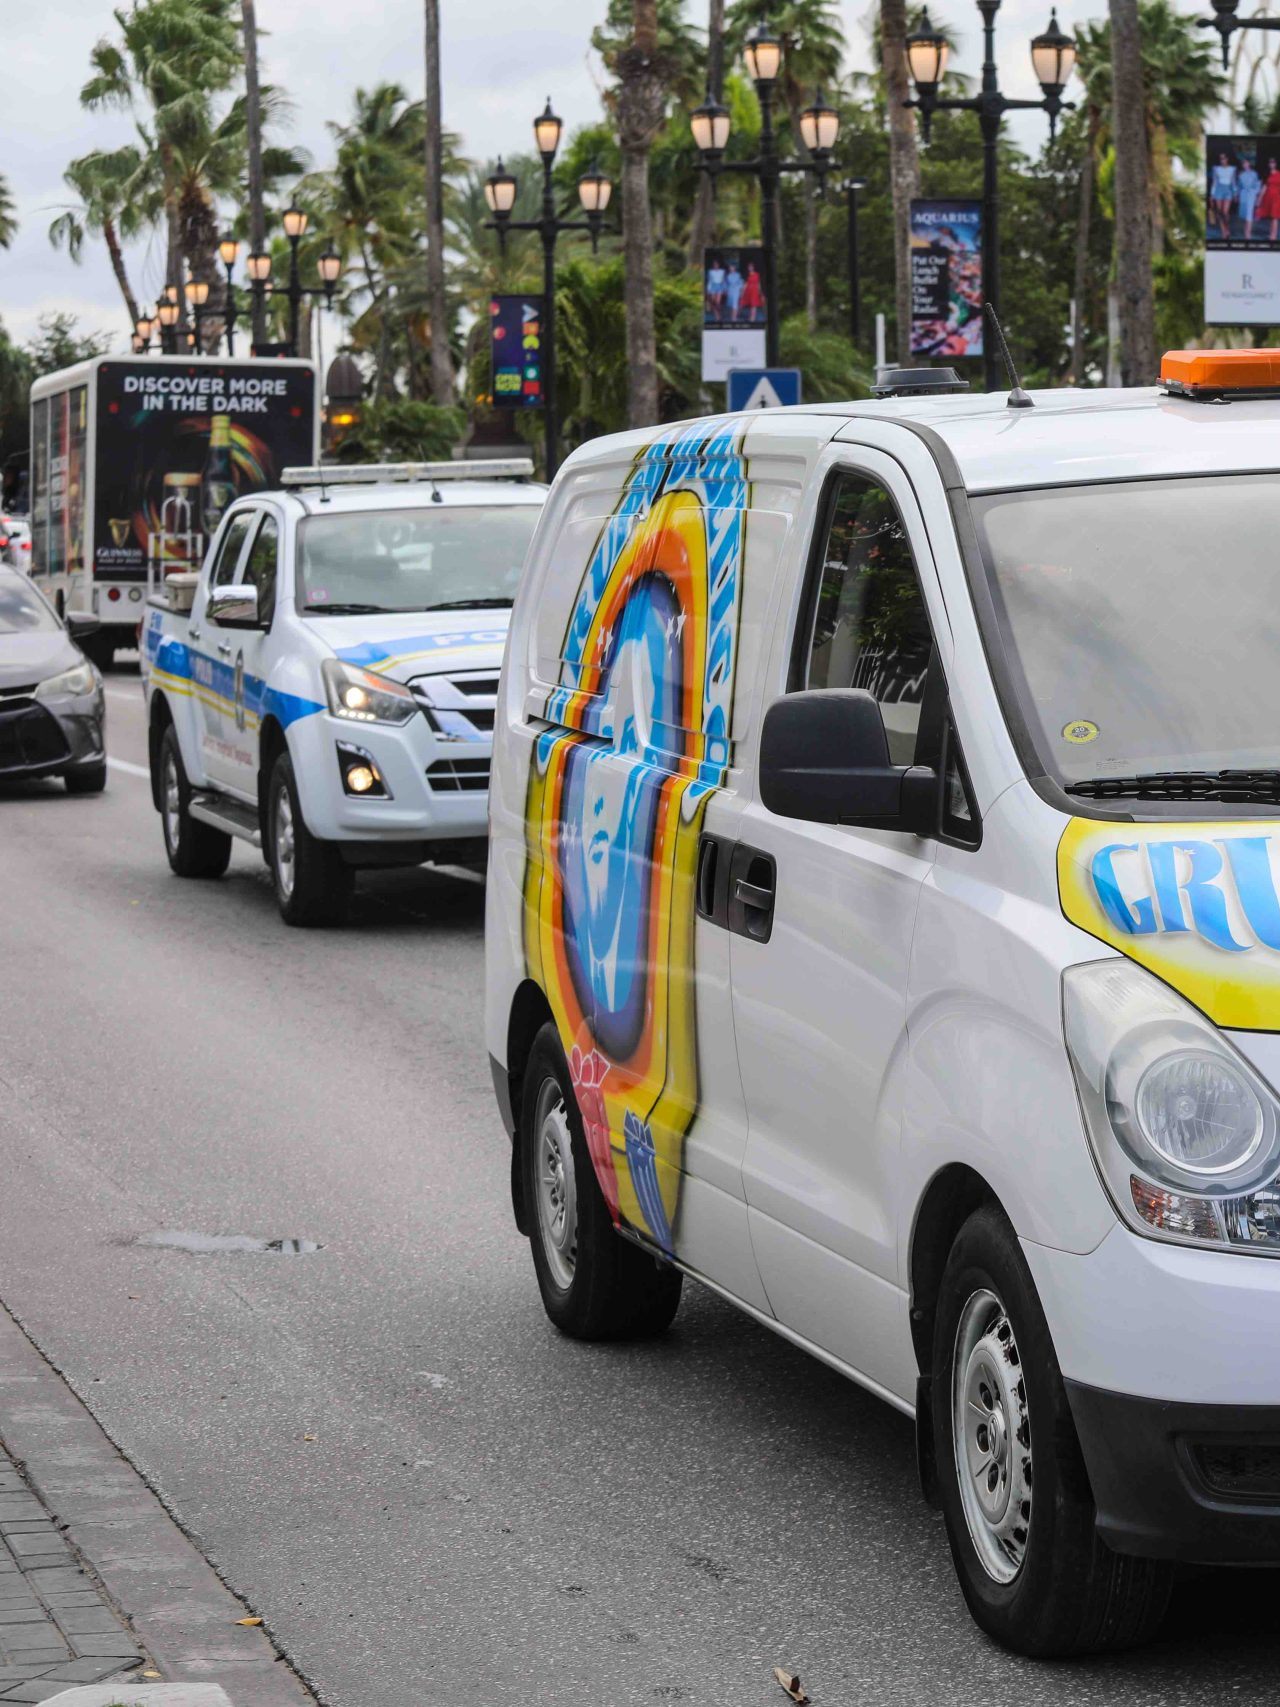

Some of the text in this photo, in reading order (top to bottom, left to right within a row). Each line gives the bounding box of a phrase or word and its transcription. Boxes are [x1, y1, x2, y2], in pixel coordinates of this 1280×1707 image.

[913, 212, 979, 225] AQUARIUS
[124, 377, 288, 396] DISCOVER MORE
[143, 396, 269, 413] IN THE DARK
